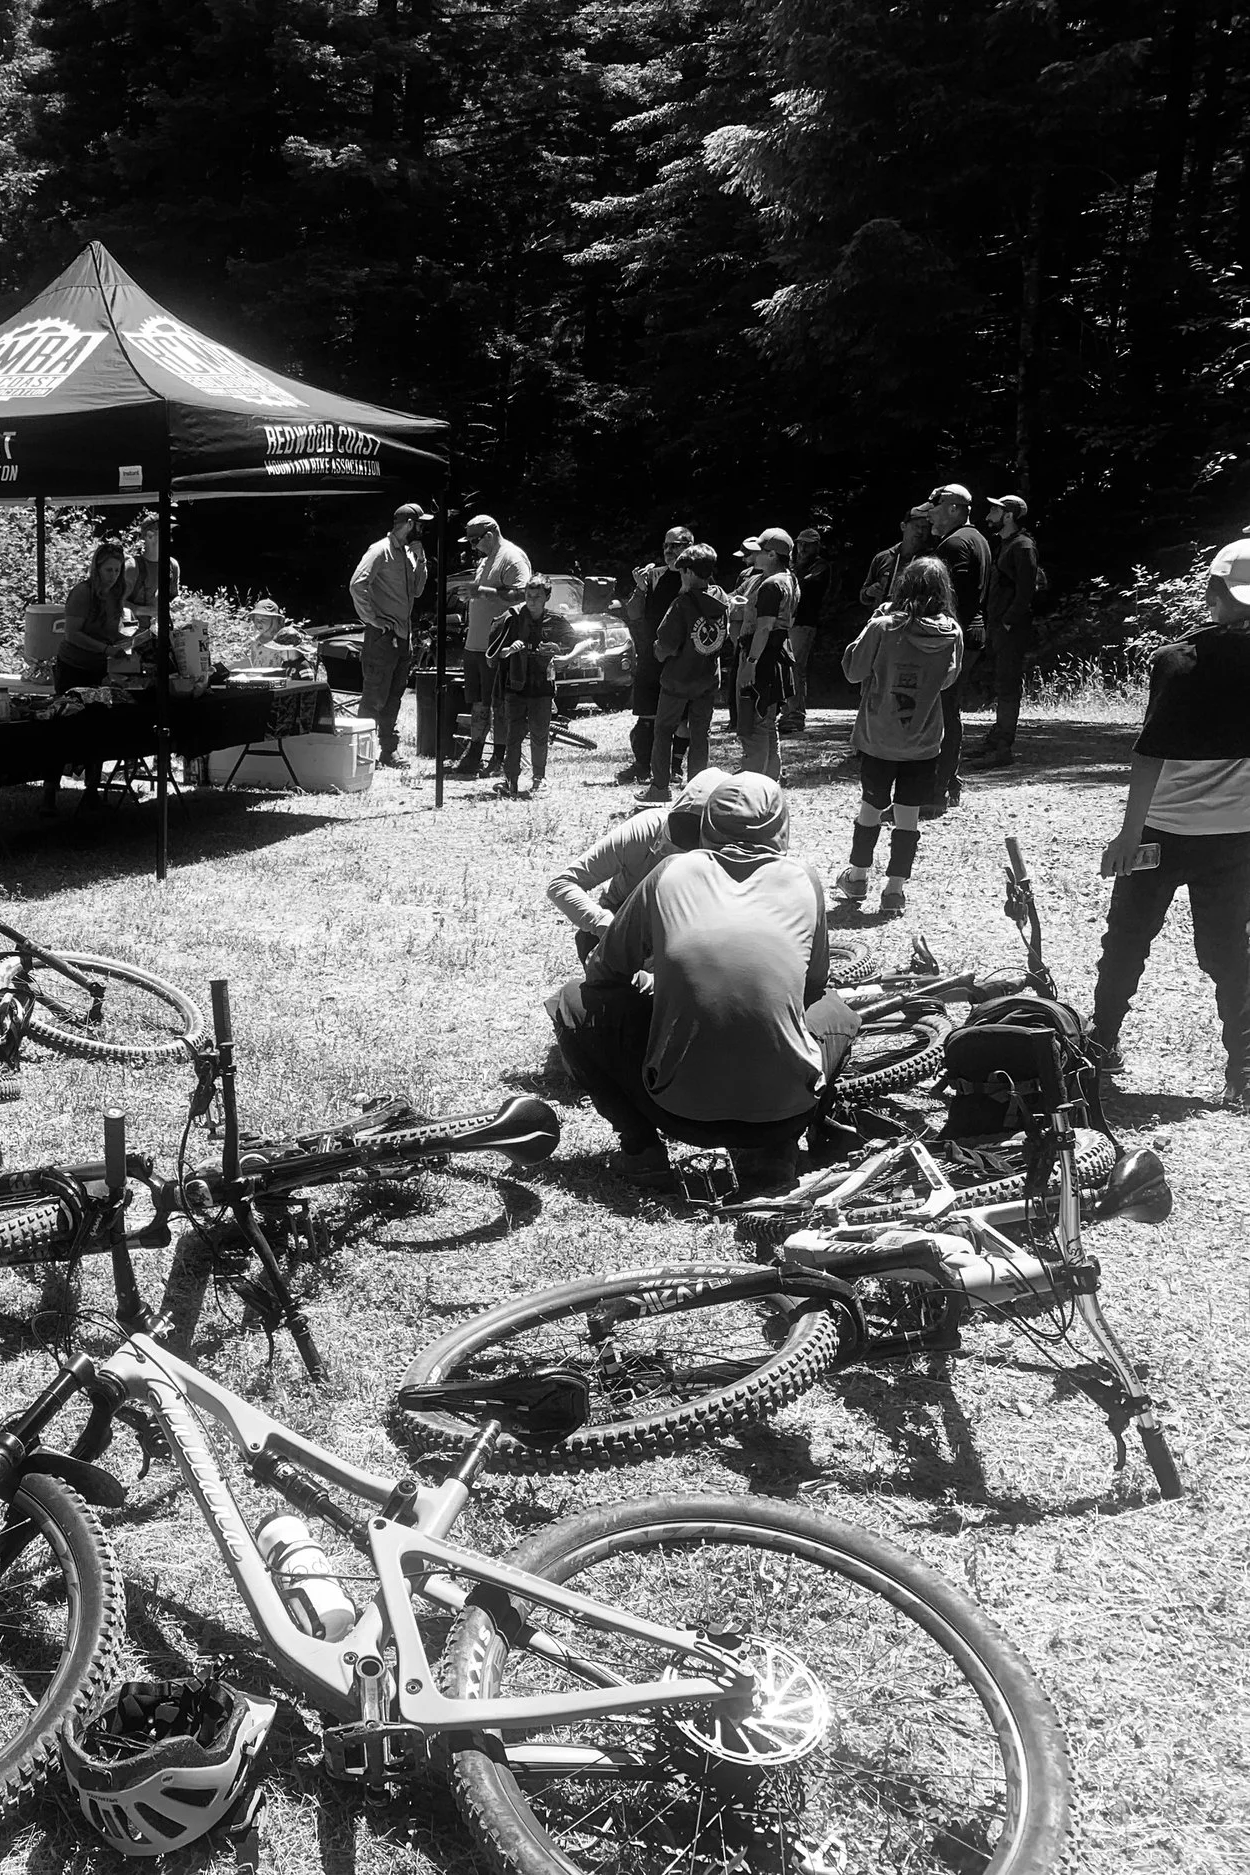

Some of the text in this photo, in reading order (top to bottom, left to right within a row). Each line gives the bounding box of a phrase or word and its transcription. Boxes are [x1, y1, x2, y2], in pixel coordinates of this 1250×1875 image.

[264, 424, 381, 455] REDWOOD COAST
[264, 457, 381, 476] MOUNTAIN BIKE ASSOCIATION
[1096, 1318, 1139, 1385] CHROMAG
[465, 1624, 491, 1699] XXIS
